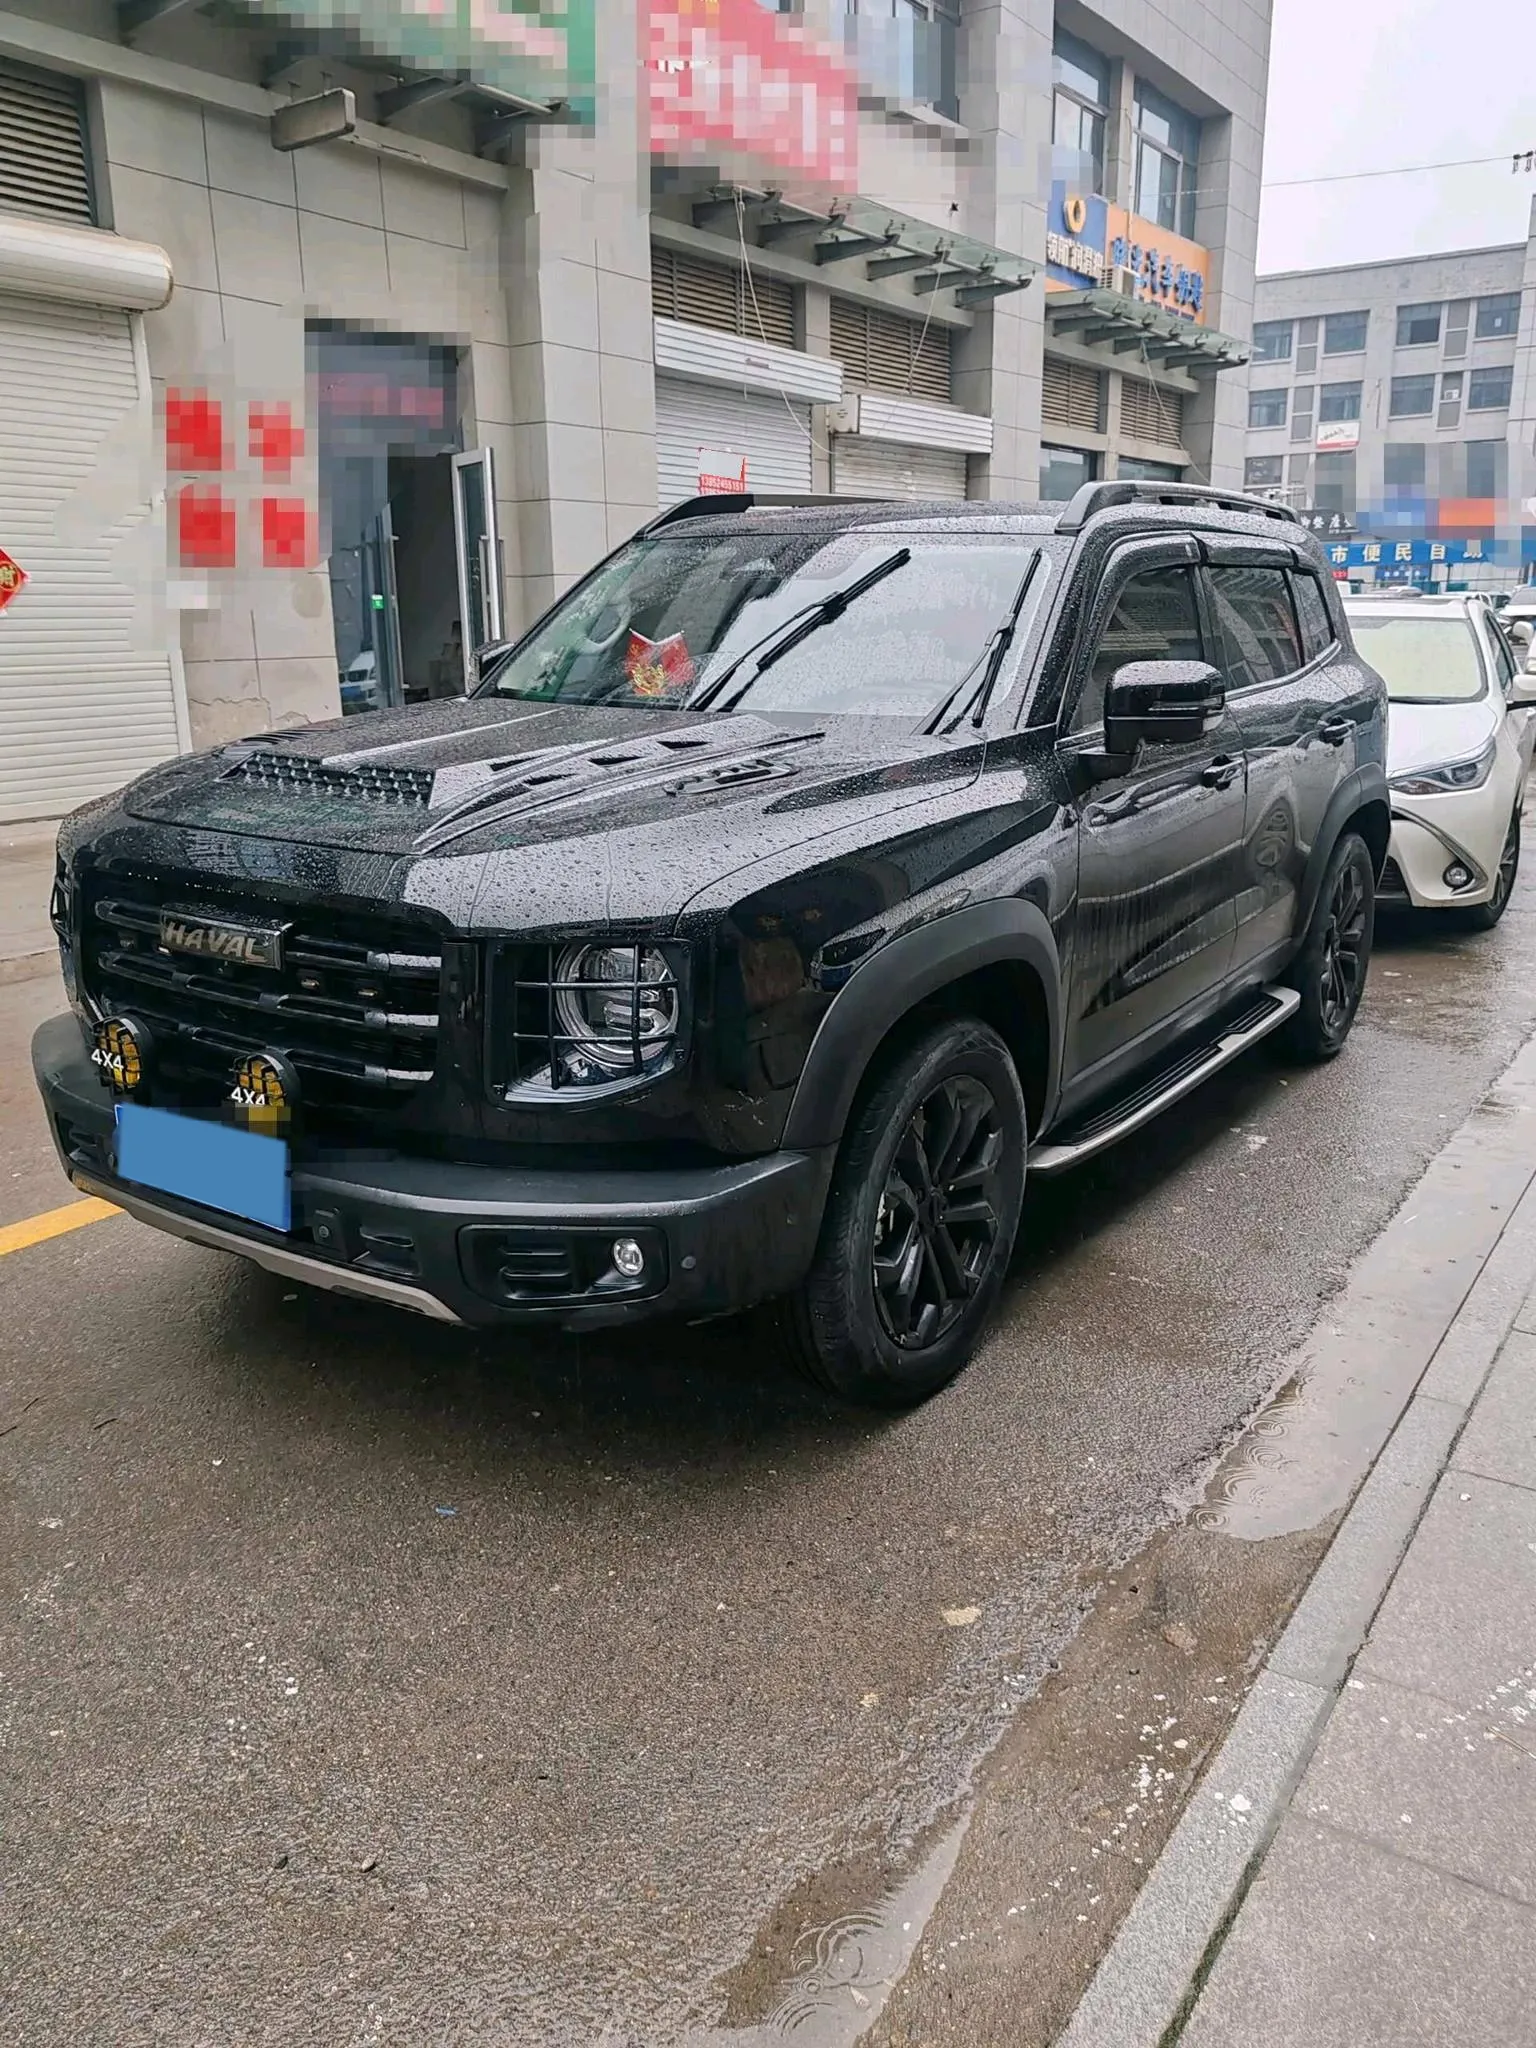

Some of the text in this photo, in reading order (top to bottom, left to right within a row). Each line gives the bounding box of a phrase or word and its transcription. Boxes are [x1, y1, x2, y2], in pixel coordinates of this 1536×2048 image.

[1331, 543, 1483, 564] 市便民自
[165, 921, 267, 963] HAVAL
[91, 1048, 124, 1070] 4X4
